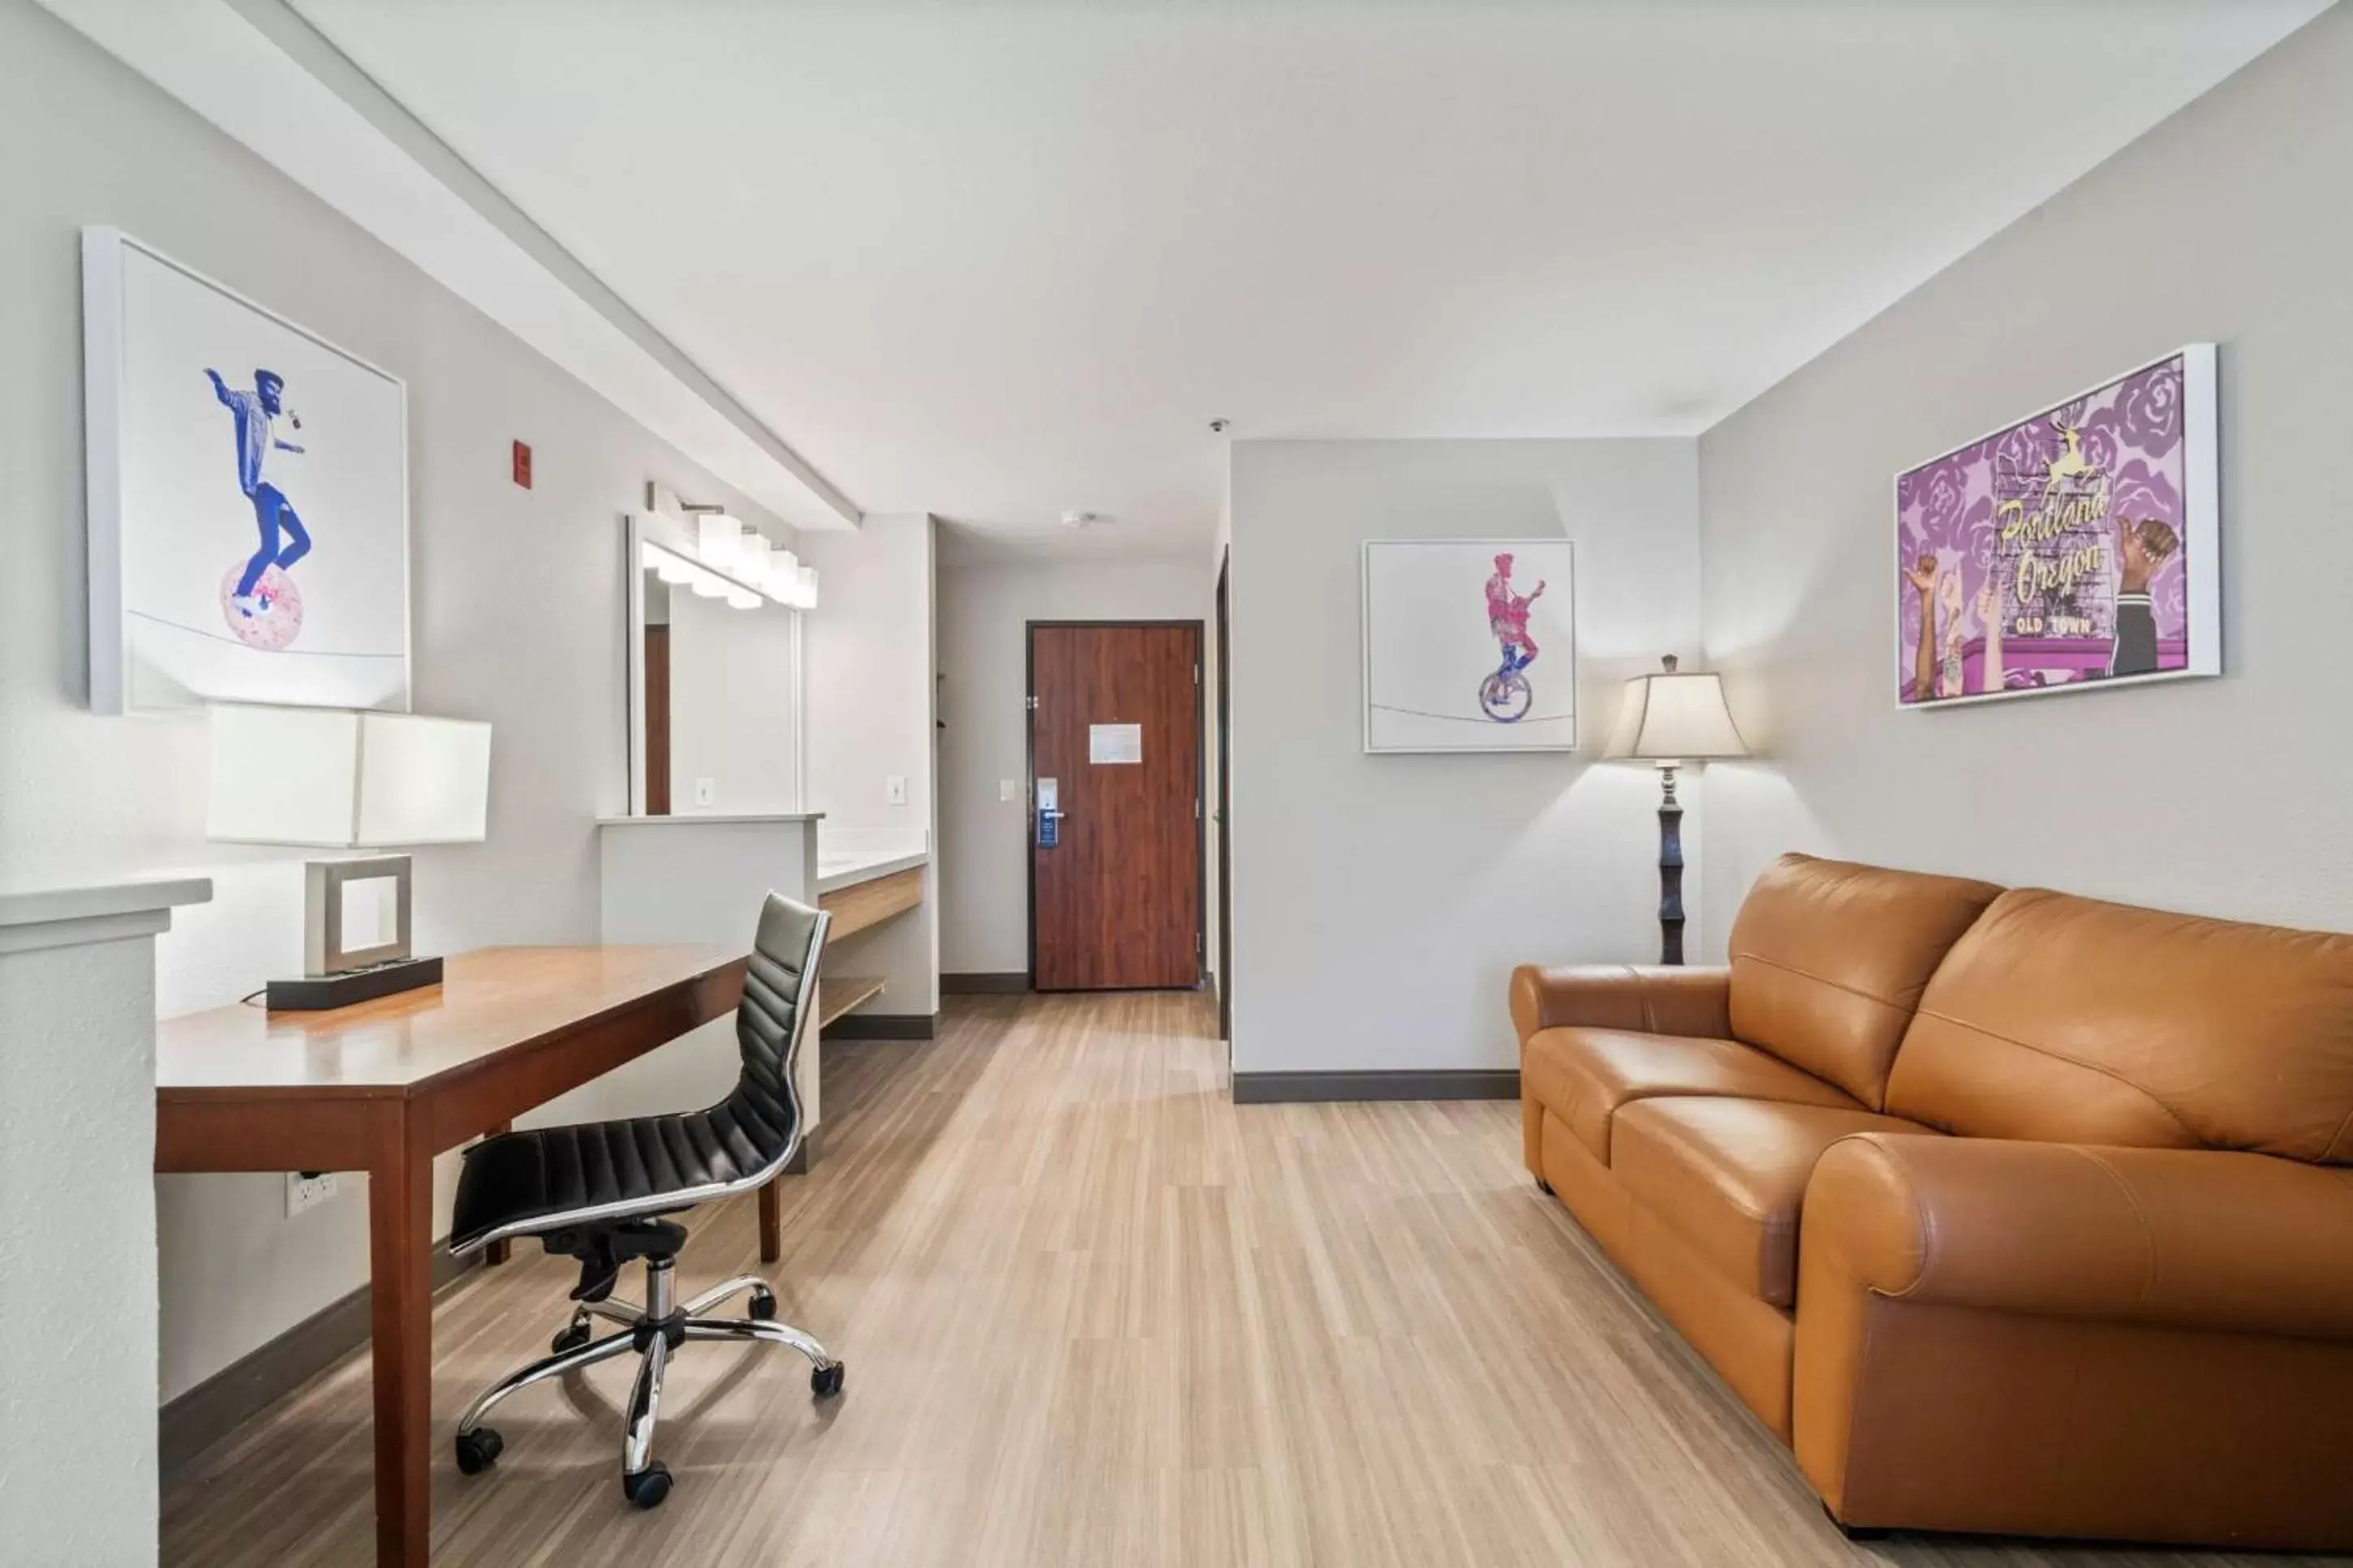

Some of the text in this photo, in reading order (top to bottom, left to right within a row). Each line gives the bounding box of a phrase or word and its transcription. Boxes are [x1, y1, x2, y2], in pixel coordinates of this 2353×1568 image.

[1999, 473, 2108, 553] Portland
[2015, 545, 2100, 603] Oregon
[2015, 616, 2043, 634] OLD
